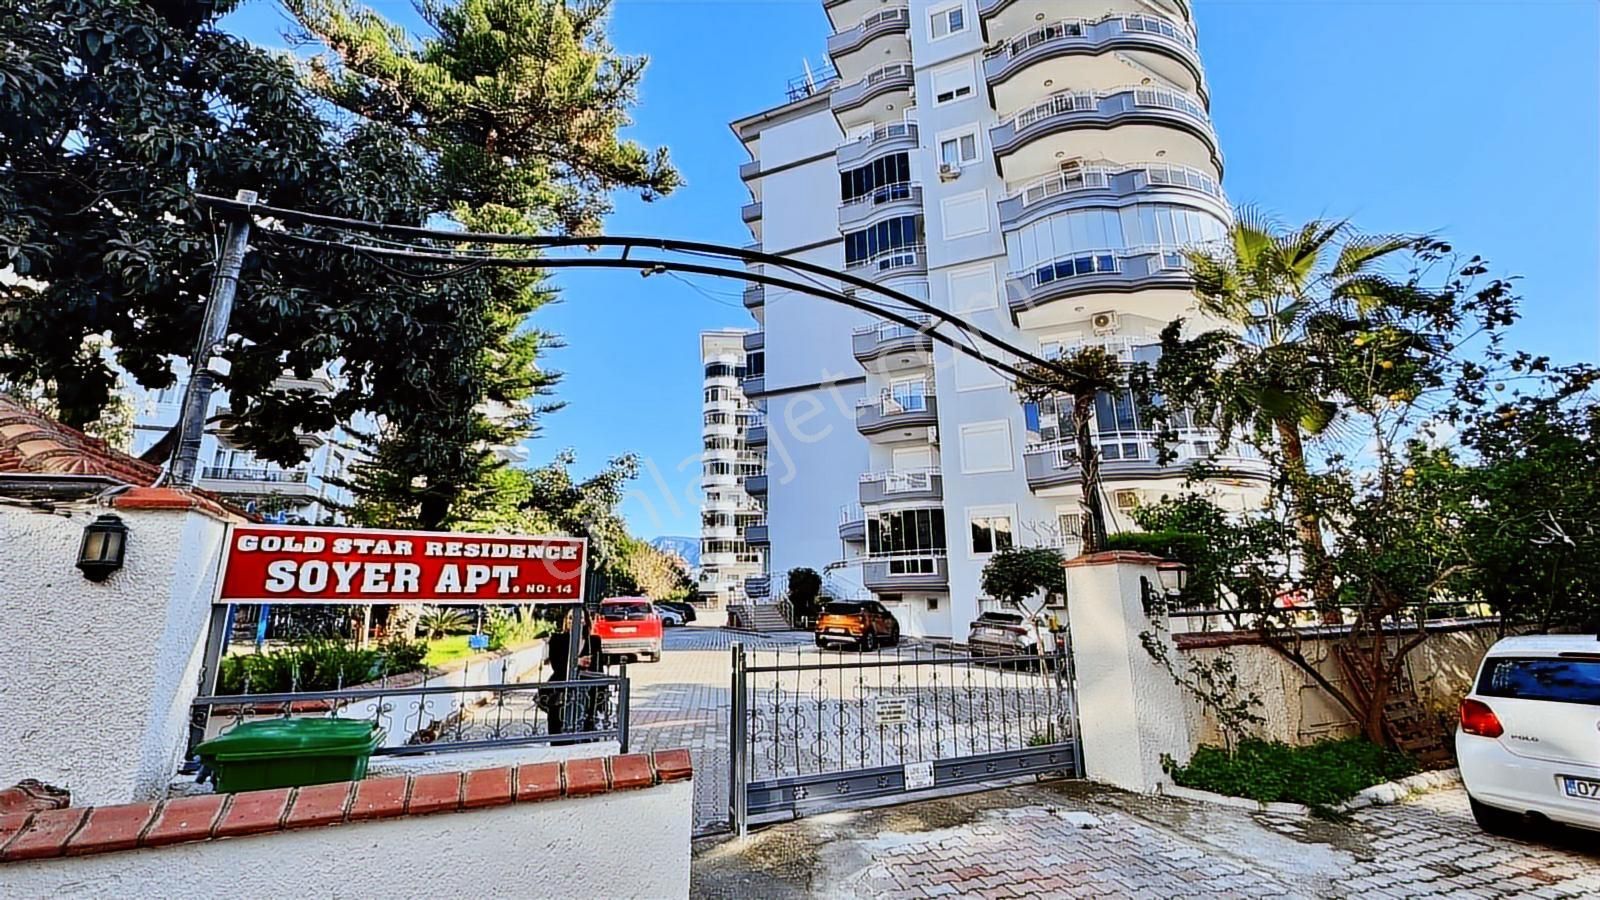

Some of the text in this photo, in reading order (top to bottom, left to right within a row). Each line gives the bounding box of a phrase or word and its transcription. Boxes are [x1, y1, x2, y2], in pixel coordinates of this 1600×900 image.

[237, 535, 577, 560] GOLD STAR RESIDENCE
[265, 560, 572, 594] SOYER APT. NO: 14
[1511, 734, 1539, 743] POLO
[1577, 782, 1600, 797] 07
